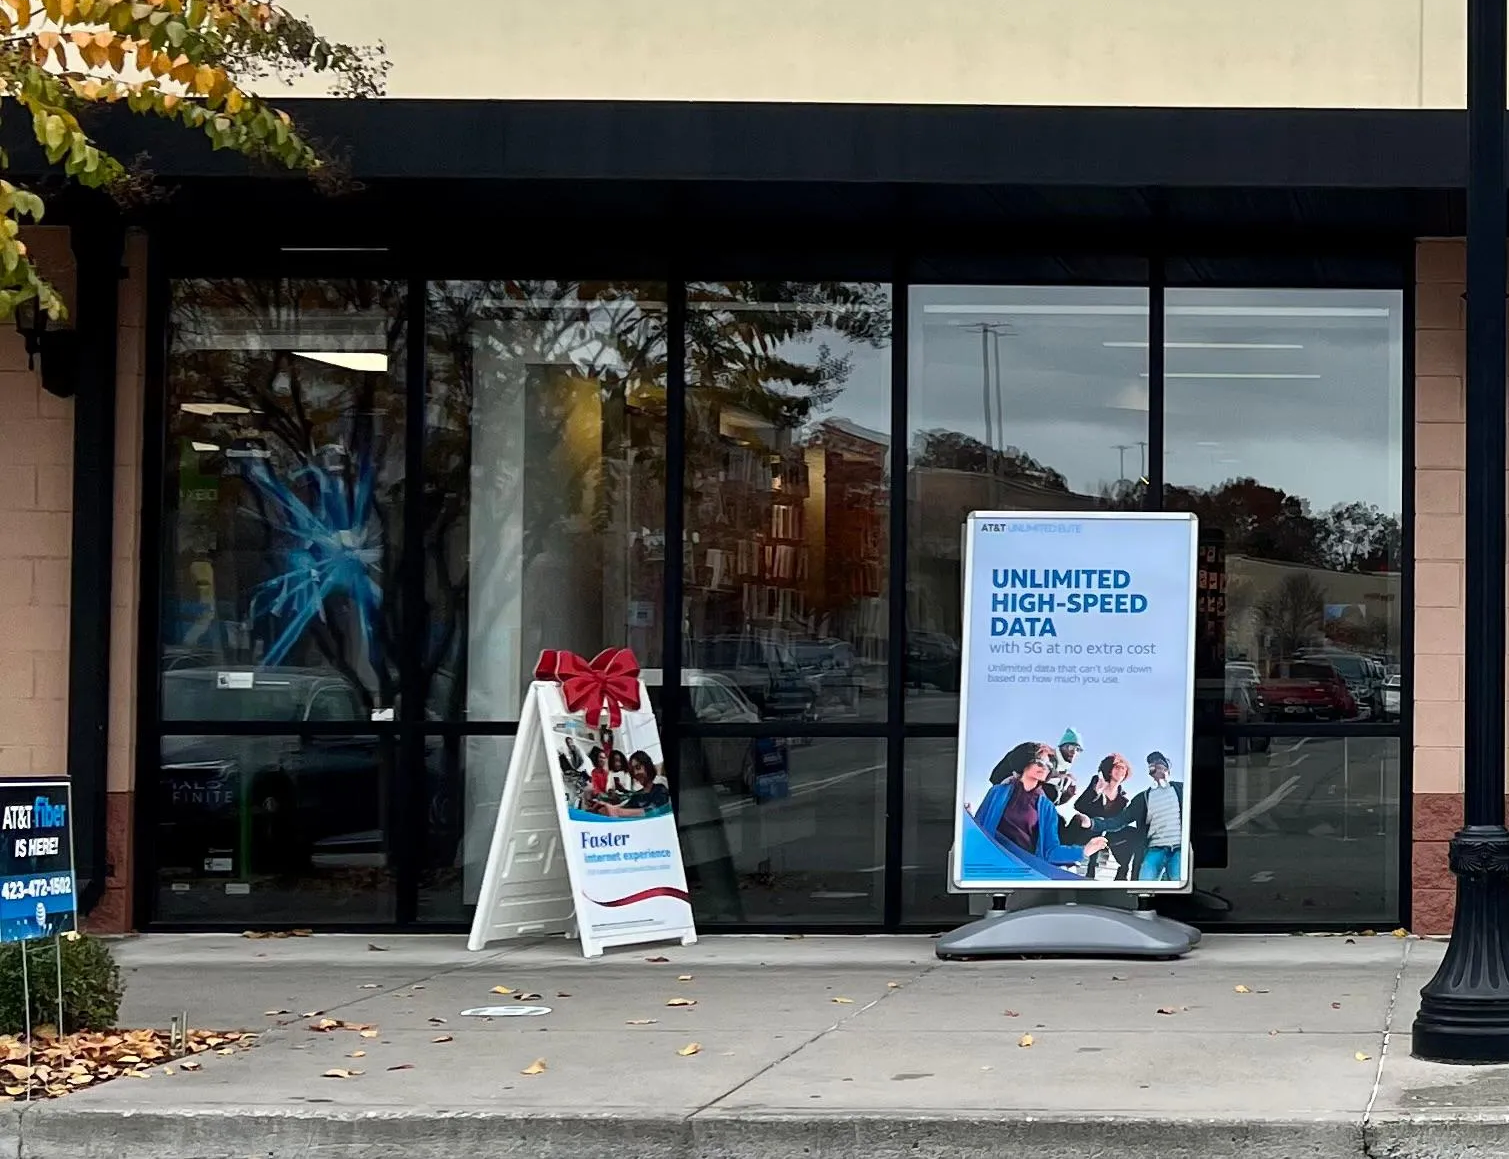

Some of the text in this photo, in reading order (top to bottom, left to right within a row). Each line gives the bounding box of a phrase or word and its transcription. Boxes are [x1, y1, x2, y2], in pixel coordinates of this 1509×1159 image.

[981, 523, 1006, 532] AT&T
[992, 569, 1131, 589] UNLIMITED
[992, 593, 1148, 613] HIGH-SPEED
[991, 617, 1057, 637] DATA
[989, 641, 1156, 655] with 5G at no extra cost
[988, 664, 1032, 673] Unlimited
[1035, 664, 1055, 673] data
[1058, 664, 1076, 673] that
[1104, 665, 1124, 673] slow
[1127, 665, 1152, 673] down
[987, 674, 1016, 683] based
[1032, 674, 1050, 683] how
[1054, 674, 1080, 683] much
[1082, 676, 1099, 685] you
[2, 796, 66, 830] AT&T fiber
[15, 837, 59, 857] IS HERE!
[580, 831, 630, 849] Faster
[1, 876, 72, 900] 423-472-1502
